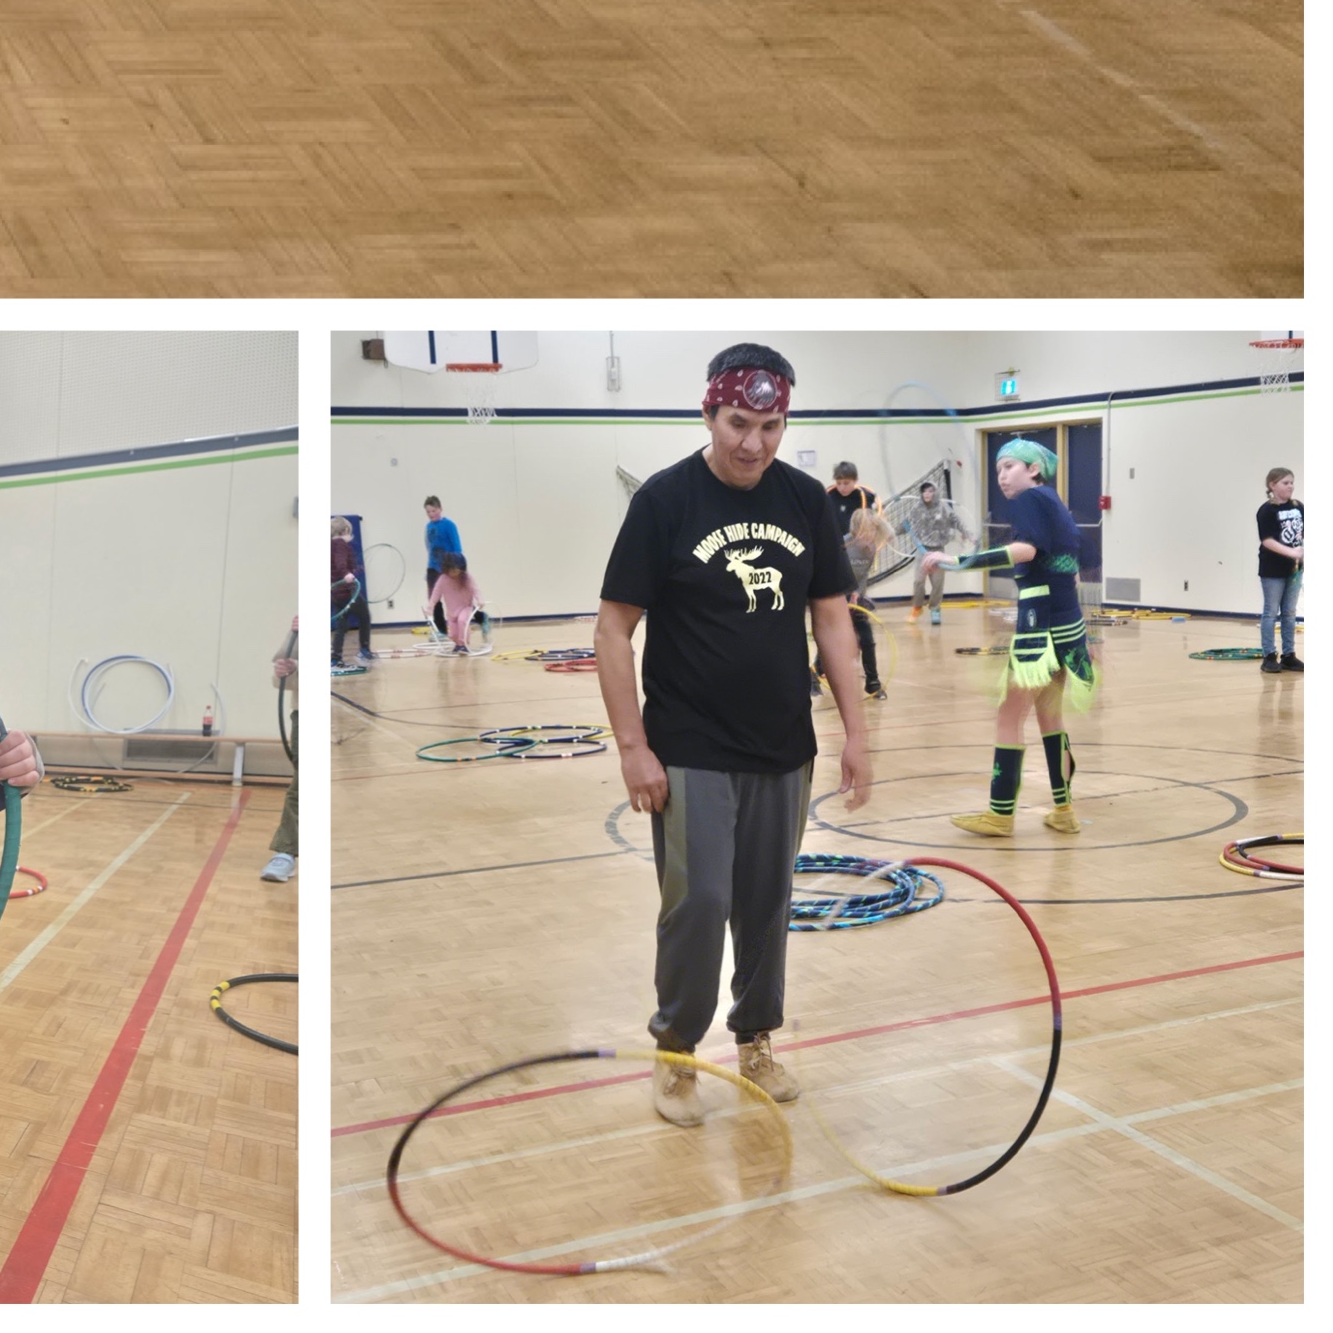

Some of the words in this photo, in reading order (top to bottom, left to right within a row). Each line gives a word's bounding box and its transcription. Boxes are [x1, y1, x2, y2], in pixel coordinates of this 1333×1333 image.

[692, 529, 728, 564] MOOSE
[723, 522, 750, 543] HIDE
[750, 522, 806, 557] CAMPAIGN
[748, 571, 772, 585] 2022
